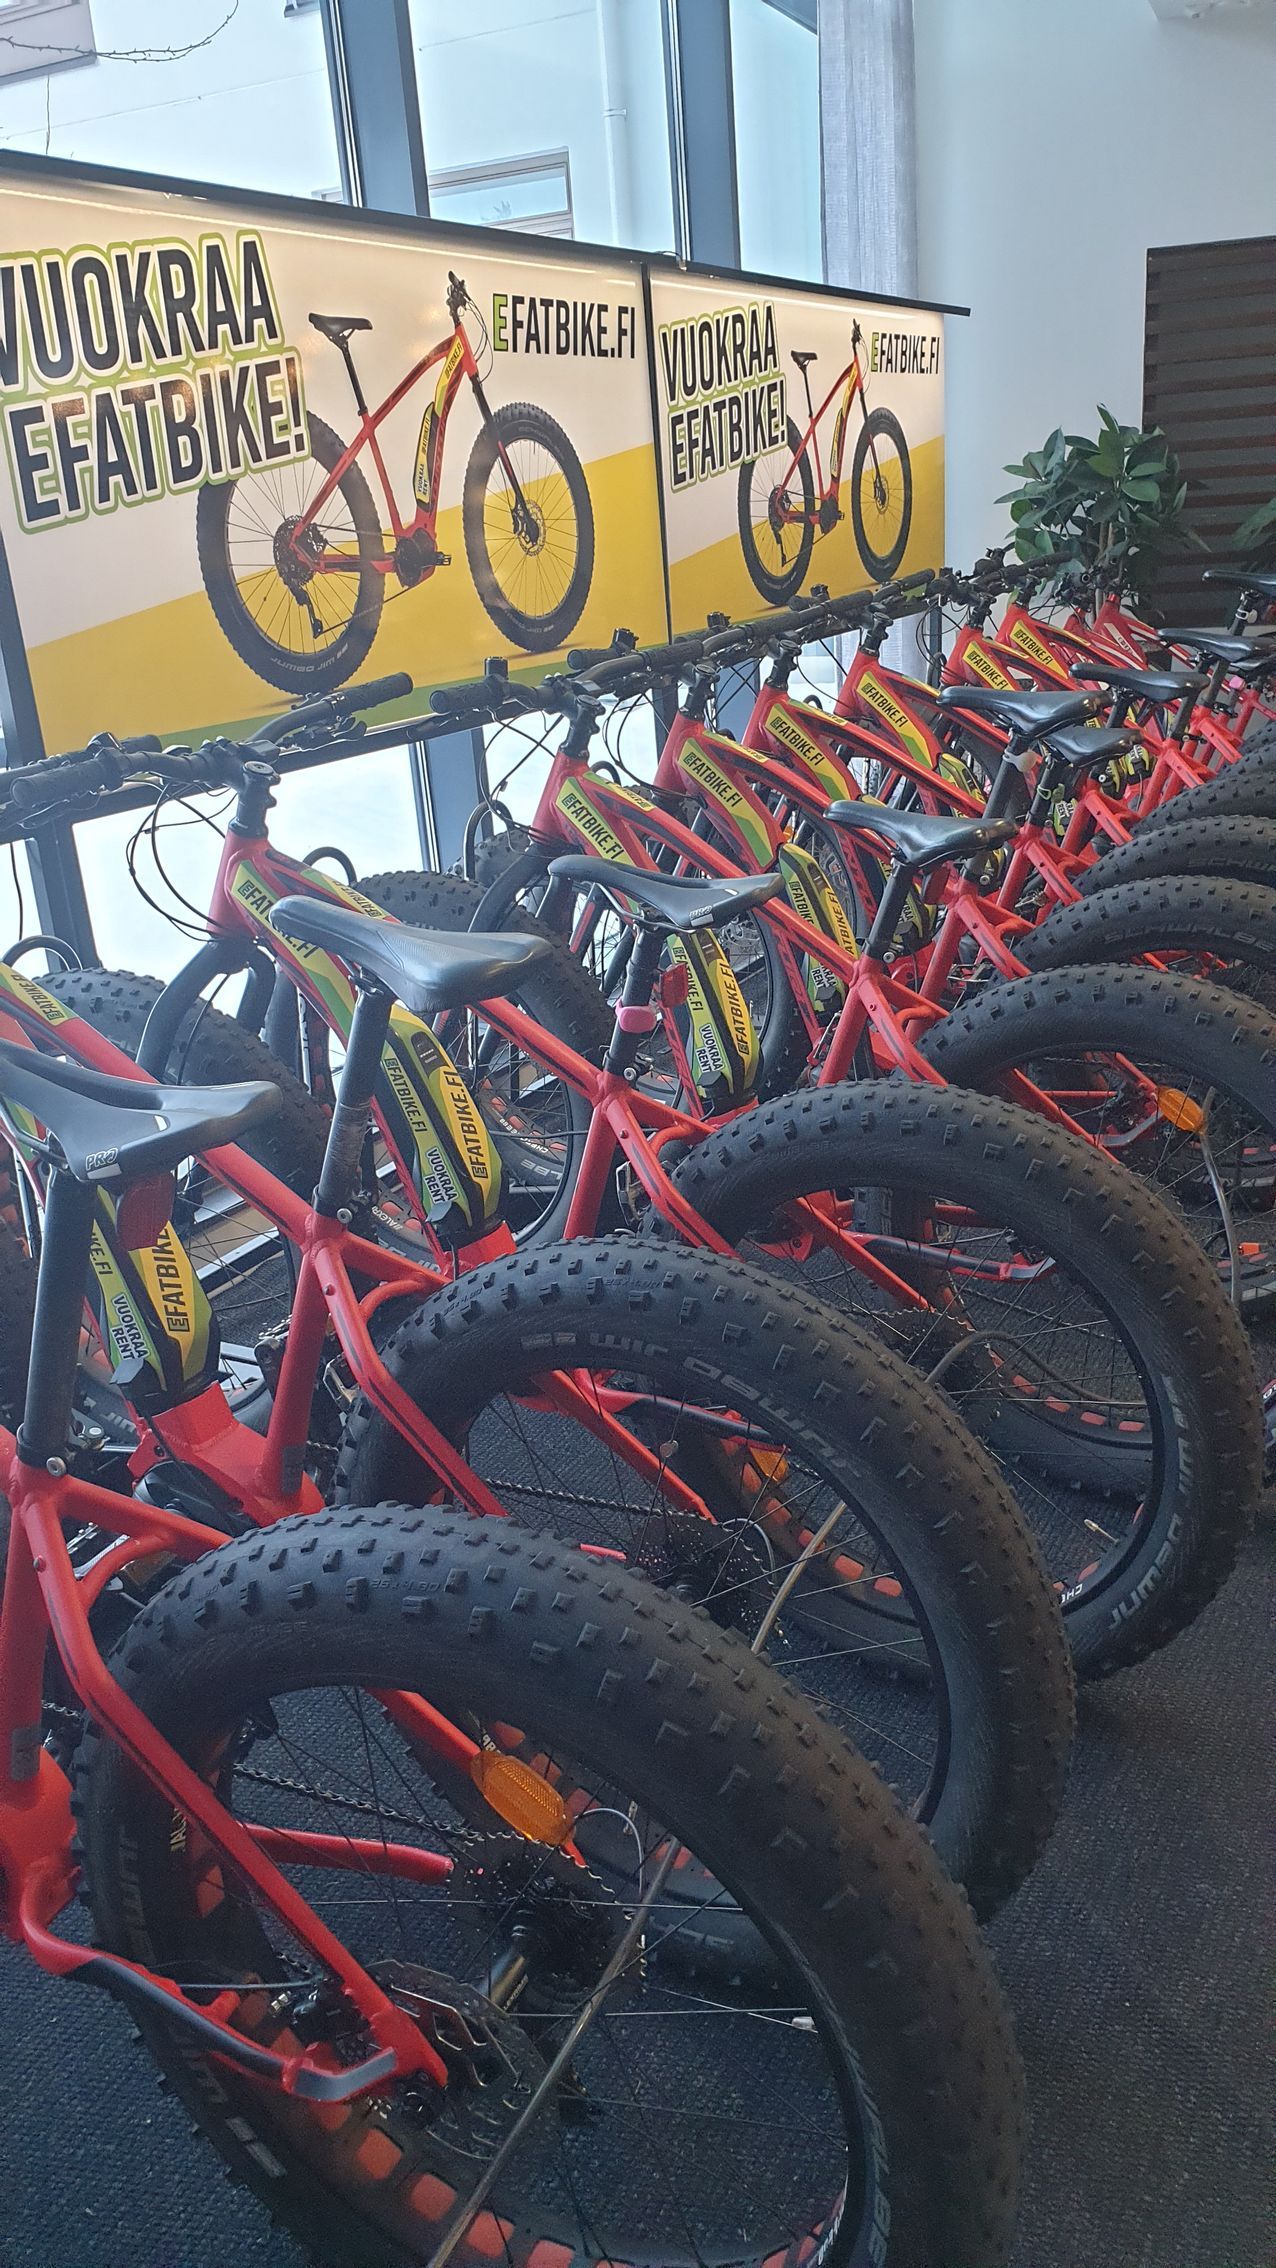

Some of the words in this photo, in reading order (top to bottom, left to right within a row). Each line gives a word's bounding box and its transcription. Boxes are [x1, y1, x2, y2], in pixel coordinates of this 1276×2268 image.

[492, 293, 636, 359] EFATBIKE.FI
[662, 305, 777, 402] VUOKRAA
[871, 332, 940, 374] EFATBIKE.FI
[9, 357, 305, 522] EFATBIKE!
[671, 379, 786, 486] EFATBIKE!
[861, 682, 908, 727] EFATBIKE.FI
[770, 716, 825, 766] EFATBIKE.FI
[683, 751, 743, 807] EFATBIKE.FI
[561, 792, 625, 860] EFATBIKE.FI
[720, 963, 749, 1056] EFATBIKE.FI
[697, 1050, 712, 1073] RENT
[701, 1025, 723, 1071] VUOKRAA
[385, 1058, 428, 1133] EFATBIKE.FI
[445, 1069, 489, 1179] EFATBIKE.FI
[86, 1148, 119, 1171] PRO
[427, 1149, 458, 1201] VUOKRAA
[425, 1176, 444, 1203] RENT
[112, 1328, 135, 1361] RENT
[113, 1296, 149, 1359] VUOKRAA
[1108, 1513, 1184, 1631] JUMBO
